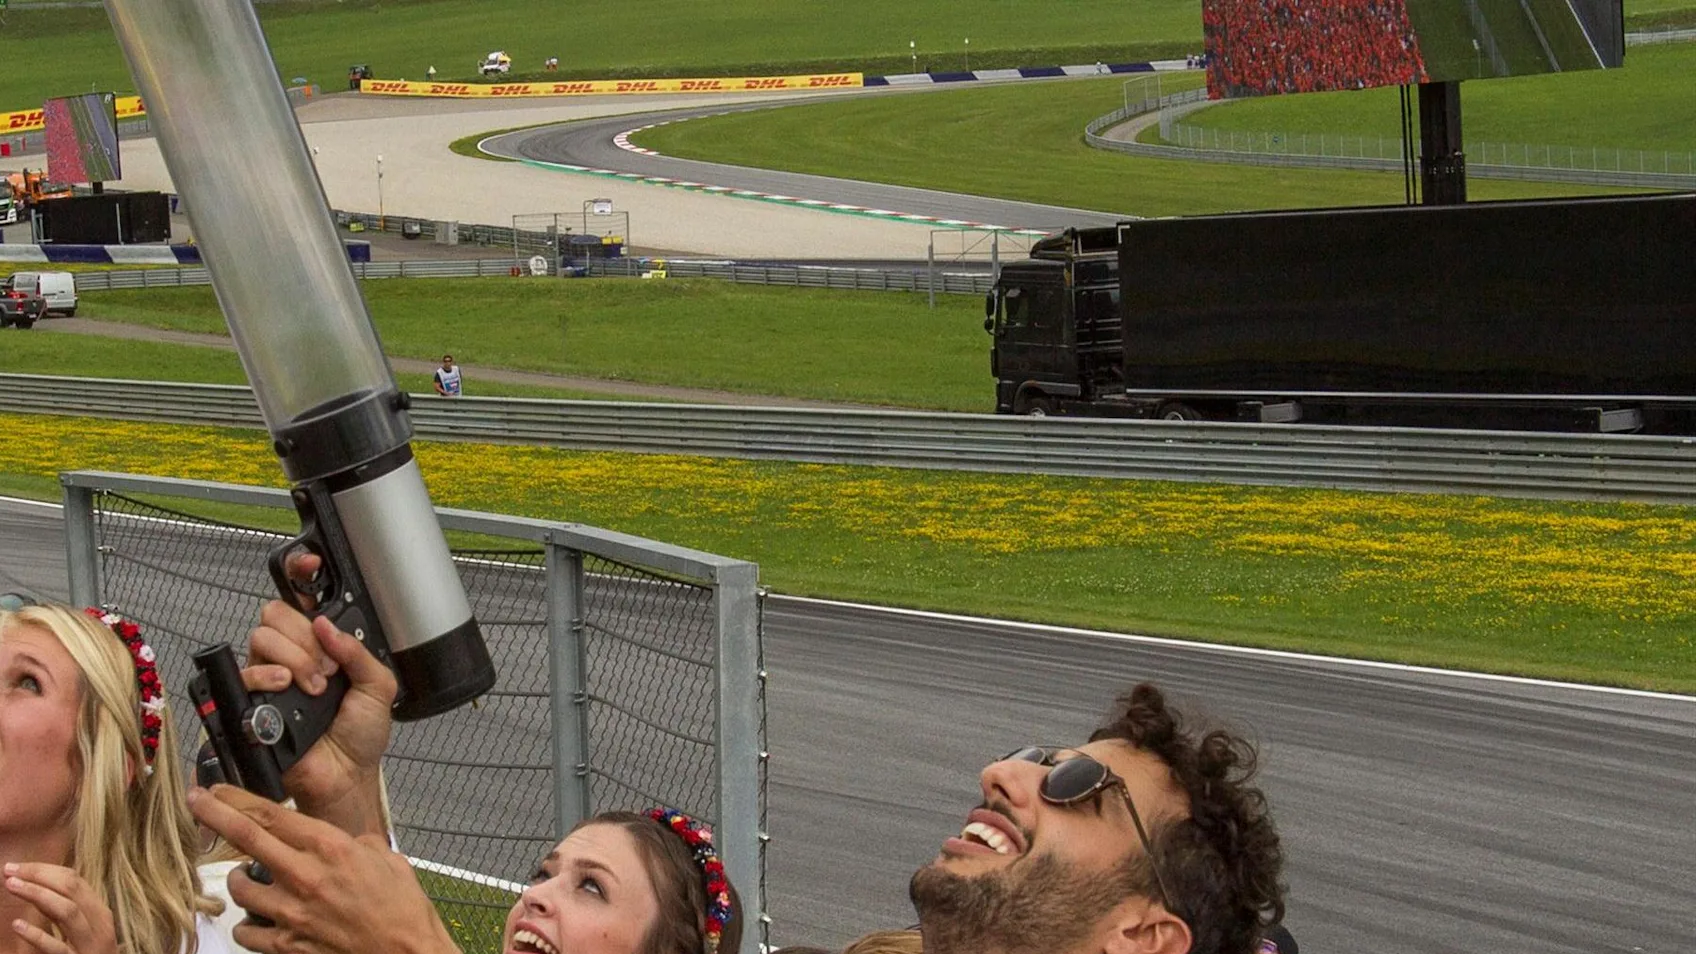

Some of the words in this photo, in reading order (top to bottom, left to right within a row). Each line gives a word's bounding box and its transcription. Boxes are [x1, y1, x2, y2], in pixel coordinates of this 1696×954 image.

[616, 81, 658, 91] DHL
[680, 80, 722, 90] DHL
[745, 78, 787, 88] DHL
[809, 76, 852, 86] DHL
[371, 82, 410, 92] DHL
[431, 84, 470, 95] DHL
[491, 85, 532, 95] DHL
[553, 83, 595, 93] DHL
[9, 111, 45, 128] DH
